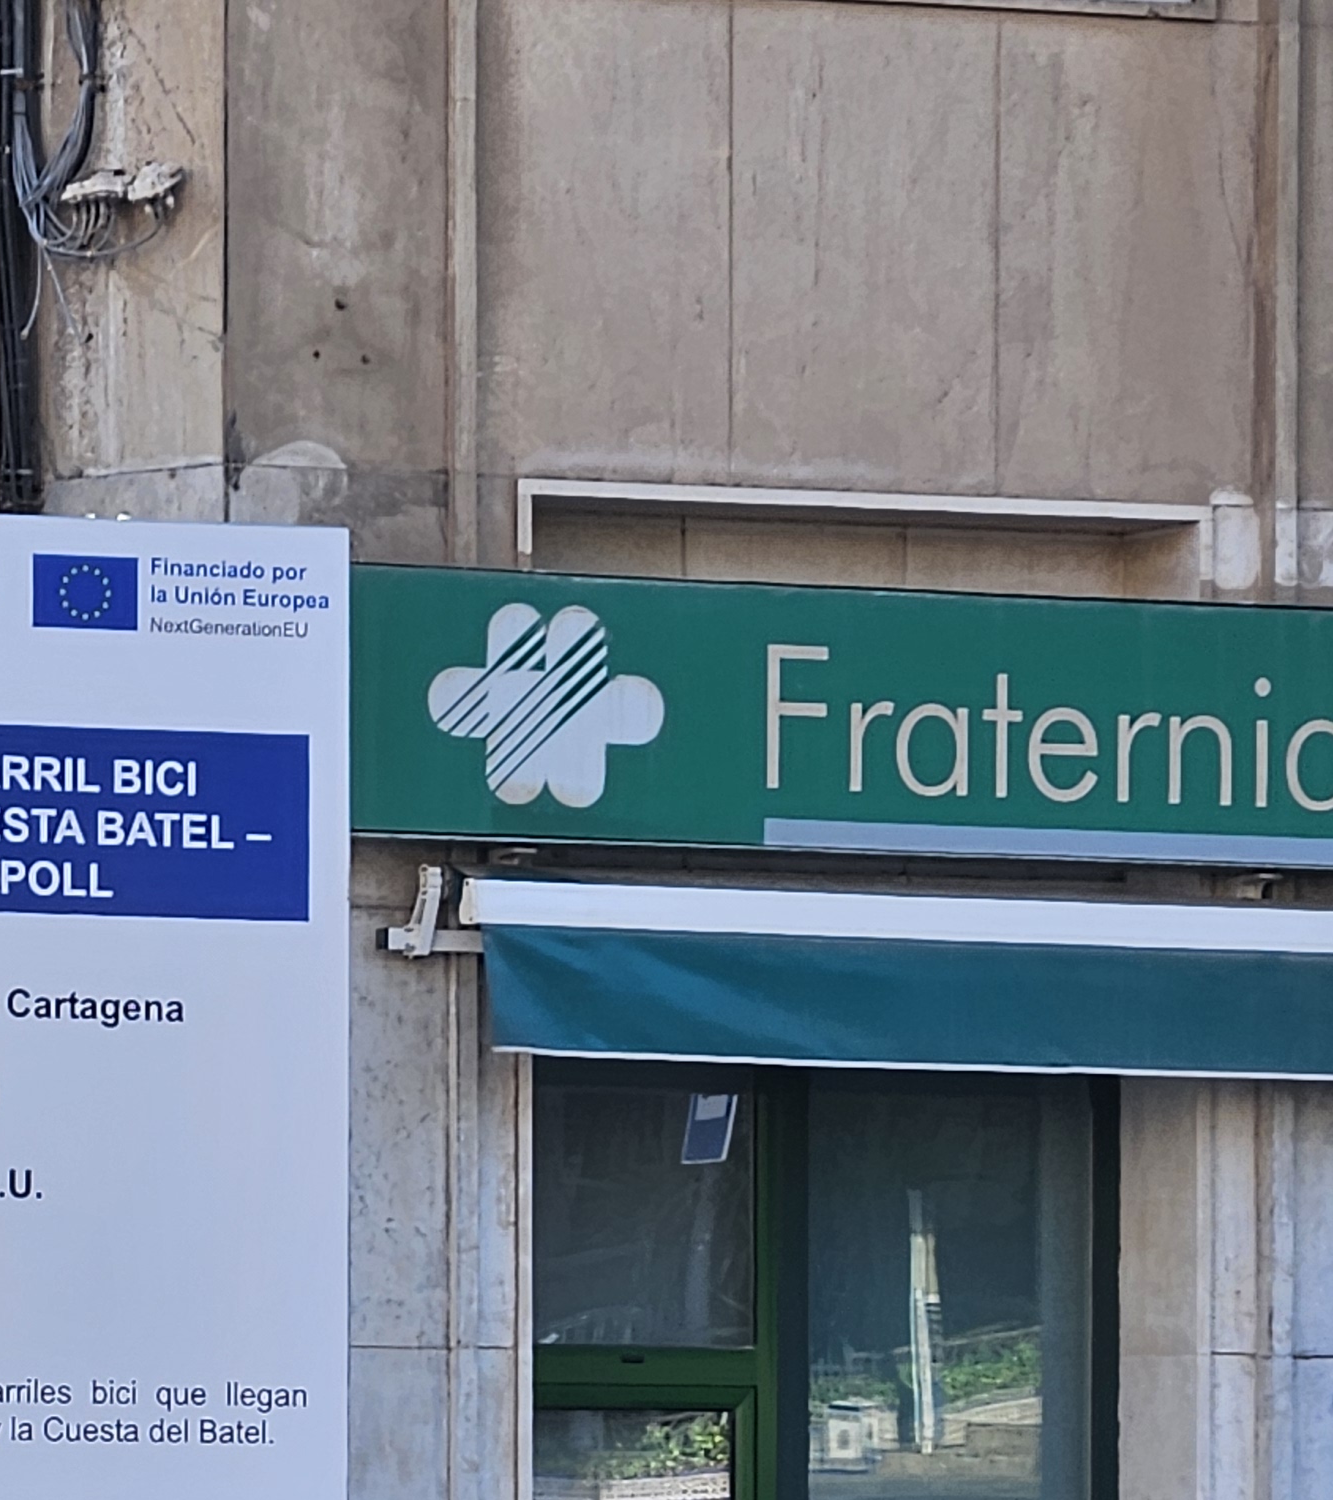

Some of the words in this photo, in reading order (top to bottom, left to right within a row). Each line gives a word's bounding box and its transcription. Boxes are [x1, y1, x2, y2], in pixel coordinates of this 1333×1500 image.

[151, 557, 265, 579] Financiado
[271, 566, 307, 584] por
[150, 584, 167, 603] la
[174, 585, 236, 606] Unión
[242, 588, 329, 613] Europea
[149, 616, 309, 639] NextGenerationEU
[113, 759, 197, 797] BICI
[97, 810, 235, 850] BATEL
[7, 988, 184, 1028] Cartagena
[92, 1379, 137, 1405] bici
[155, 1386, 207, 1413] que
[226, 1381, 307, 1414] llegan
[11, 1416, 33, 1442] la
[43, 1416, 139, 1443] Cuesta
[149, 1417, 189, 1444] del
[199, 1419, 274, 1444] Batel.
